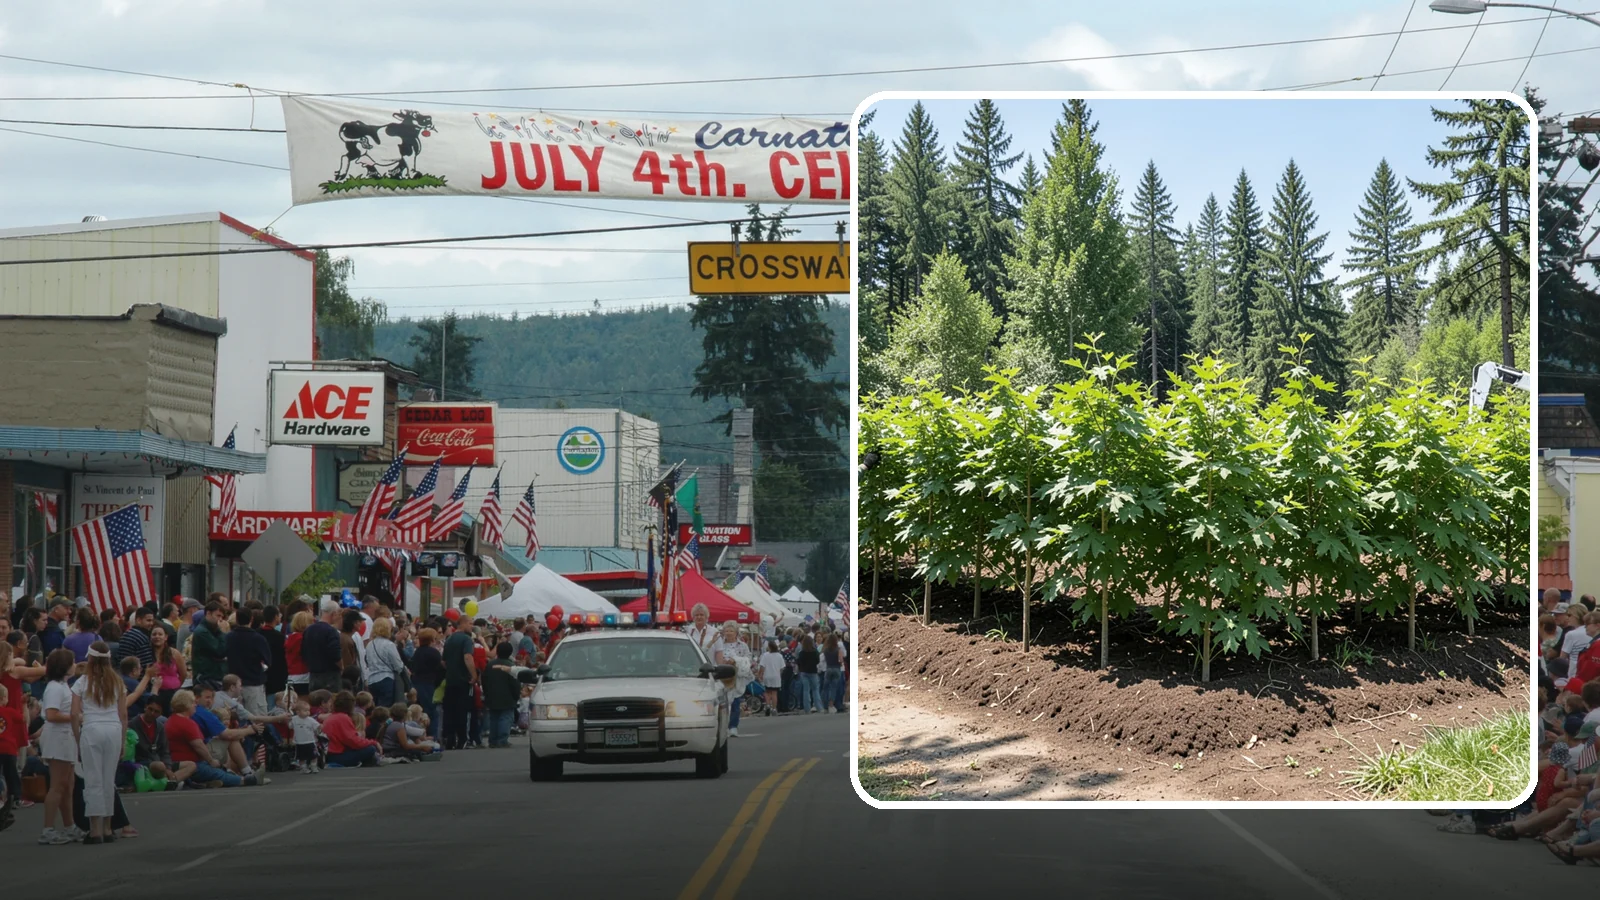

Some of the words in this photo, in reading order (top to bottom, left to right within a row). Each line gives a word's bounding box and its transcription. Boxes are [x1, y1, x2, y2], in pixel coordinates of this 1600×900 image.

[481, 141, 605, 193] JULY
[632, 149, 746, 198] 4th.
[697, 254, 850, 280] CROSSWA
[283, 380, 374, 420] ACE
[405, 409, 452, 422] CEDAR
[461, 409, 485, 422] LOG
[283, 421, 371, 436] Hardware
[416, 428, 477, 447] Coca-Cola
[353, 467, 384, 480] Simpl
[96, 485, 124, 495] Vincent
[126, 486, 136, 495] de
[138, 486, 155, 495] Paul
[688, 526, 741, 535] CRNATION
[699, 535, 730, 543] GLASS
